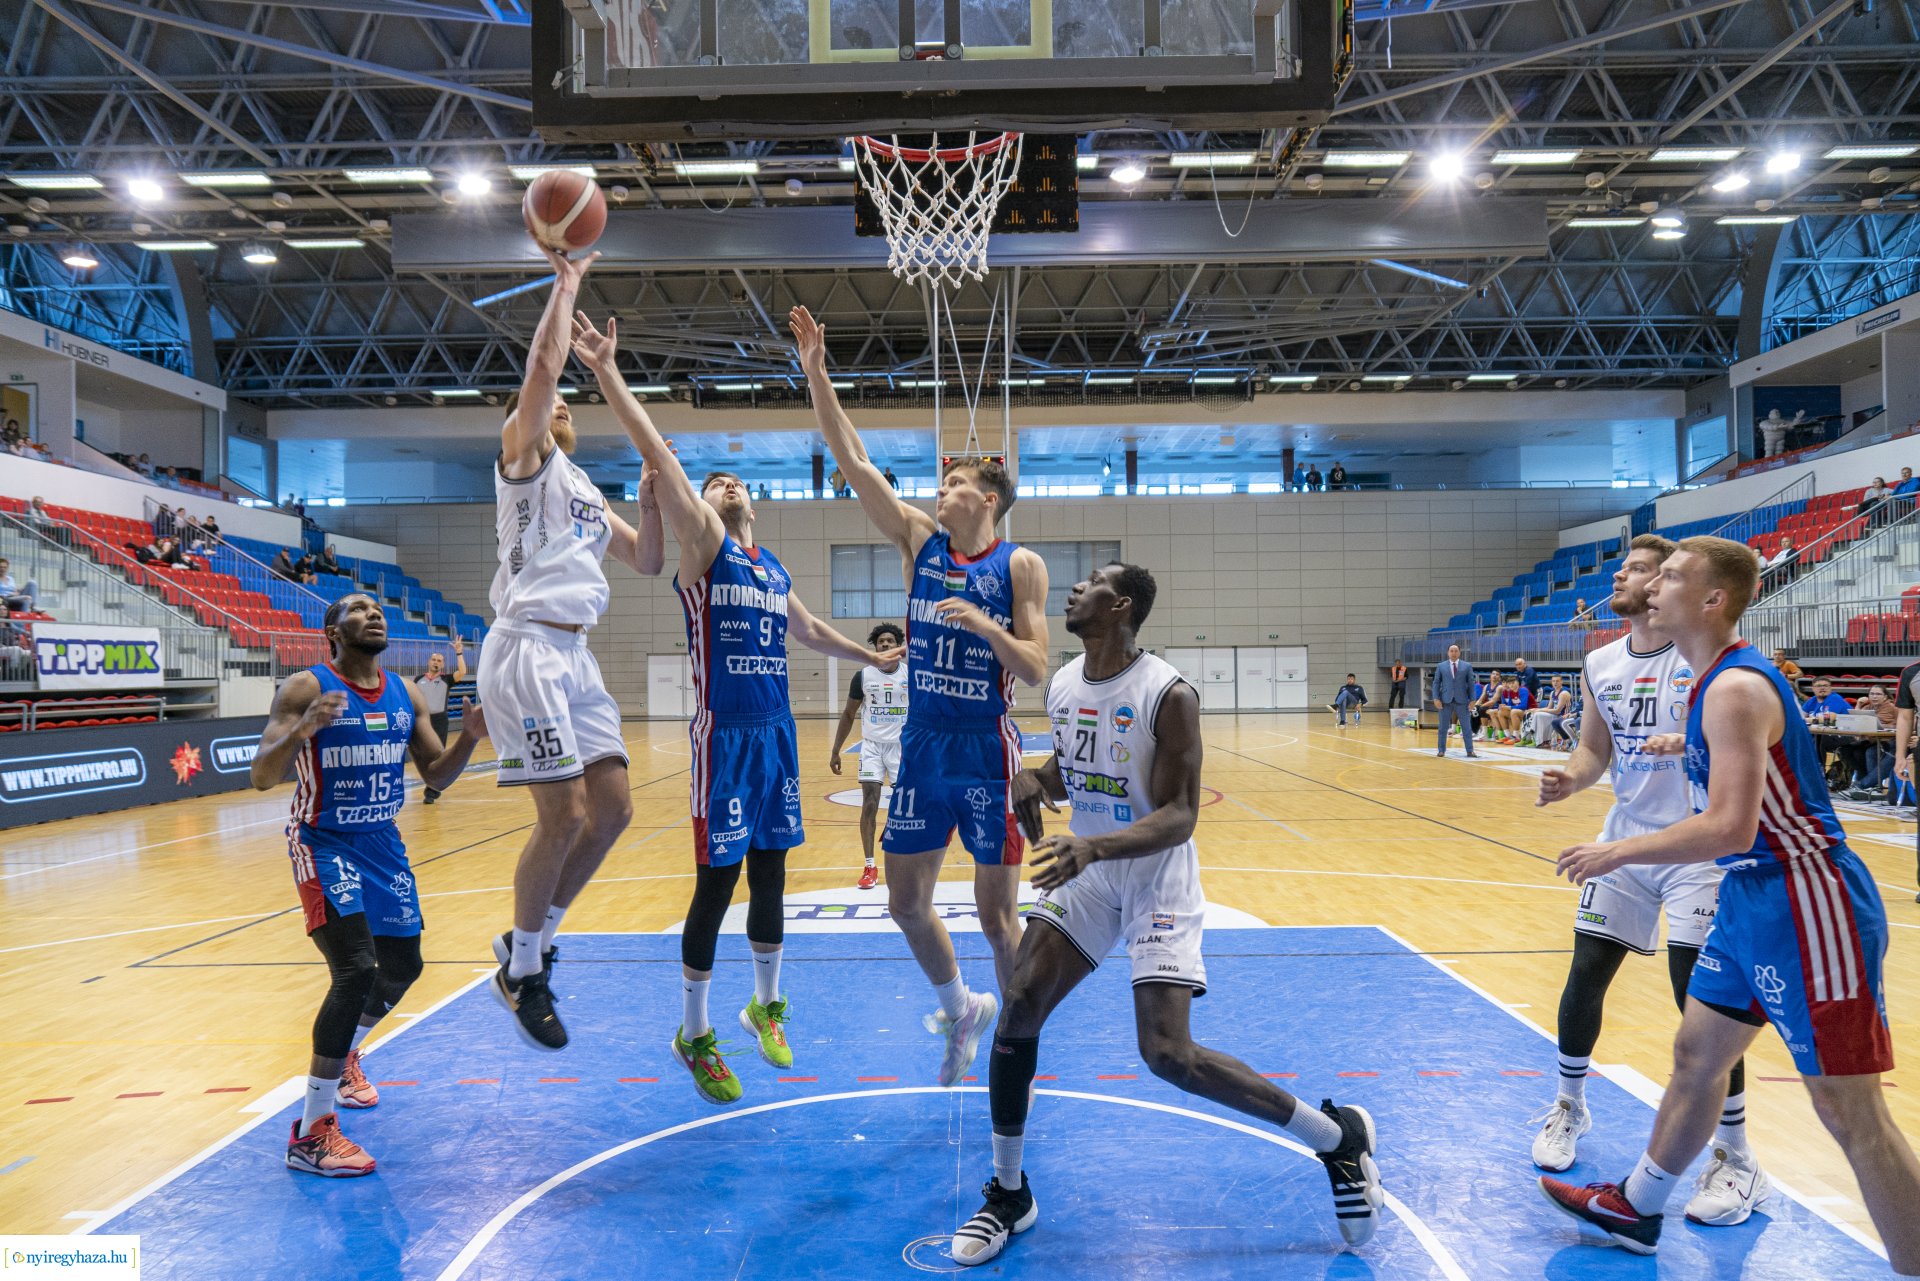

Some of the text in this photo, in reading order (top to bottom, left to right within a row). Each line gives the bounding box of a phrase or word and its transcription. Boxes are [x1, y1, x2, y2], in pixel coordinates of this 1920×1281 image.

[62, 341, 110, 368] HÜBNER
[720, 620, 751, 630] MVM
[760, 617, 773, 647] 9
[910, 637, 928, 649] MVM
[934, 635, 956, 671] 11
[965, 647, 994, 661] MVM
[1604, 684, 1623, 692] JAKO
[1629, 697, 1657, 727] 20
[526, 728, 563, 760] 35
[1075, 730, 1097, 763] 21
[2, 758, 138, 792] WWW.TIPPMIXPRO.HU
[334, 780, 365, 789] MVM
[369, 772, 391, 802] 15
[728, 797, 743, 827] 9
[894, 786, 916, 818] 11
